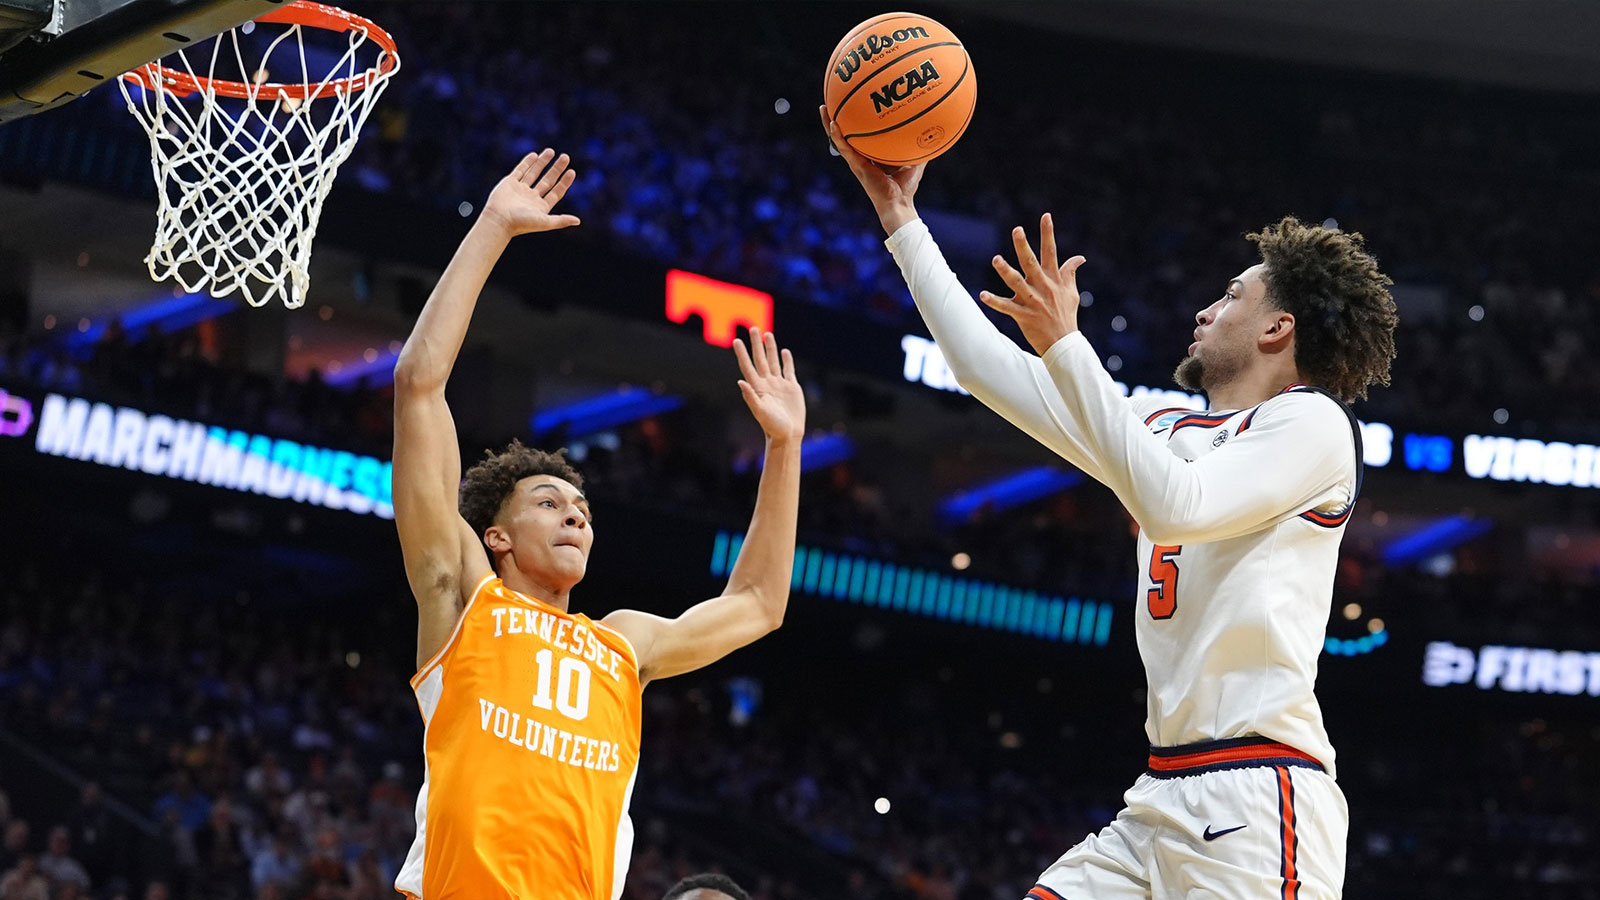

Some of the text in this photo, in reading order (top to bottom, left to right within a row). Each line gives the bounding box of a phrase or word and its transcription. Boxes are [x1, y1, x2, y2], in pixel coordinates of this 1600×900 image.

[834, 25, 930, 83] Wilson
[871, 45, 900, 64] EVO NXT
[869, 60, 940, 115] NCAA
[878, 81, 943, 120] OFFICIAL GAME BALL
[1404, 433, 1453, 472] VS
[1147, 543, 1183, 620] 5
[491, 607, 623, 682] TENNESSEE
[532, 648, 592, 721] 10
[479, 698, 620, 772] VOLUNTEERS
